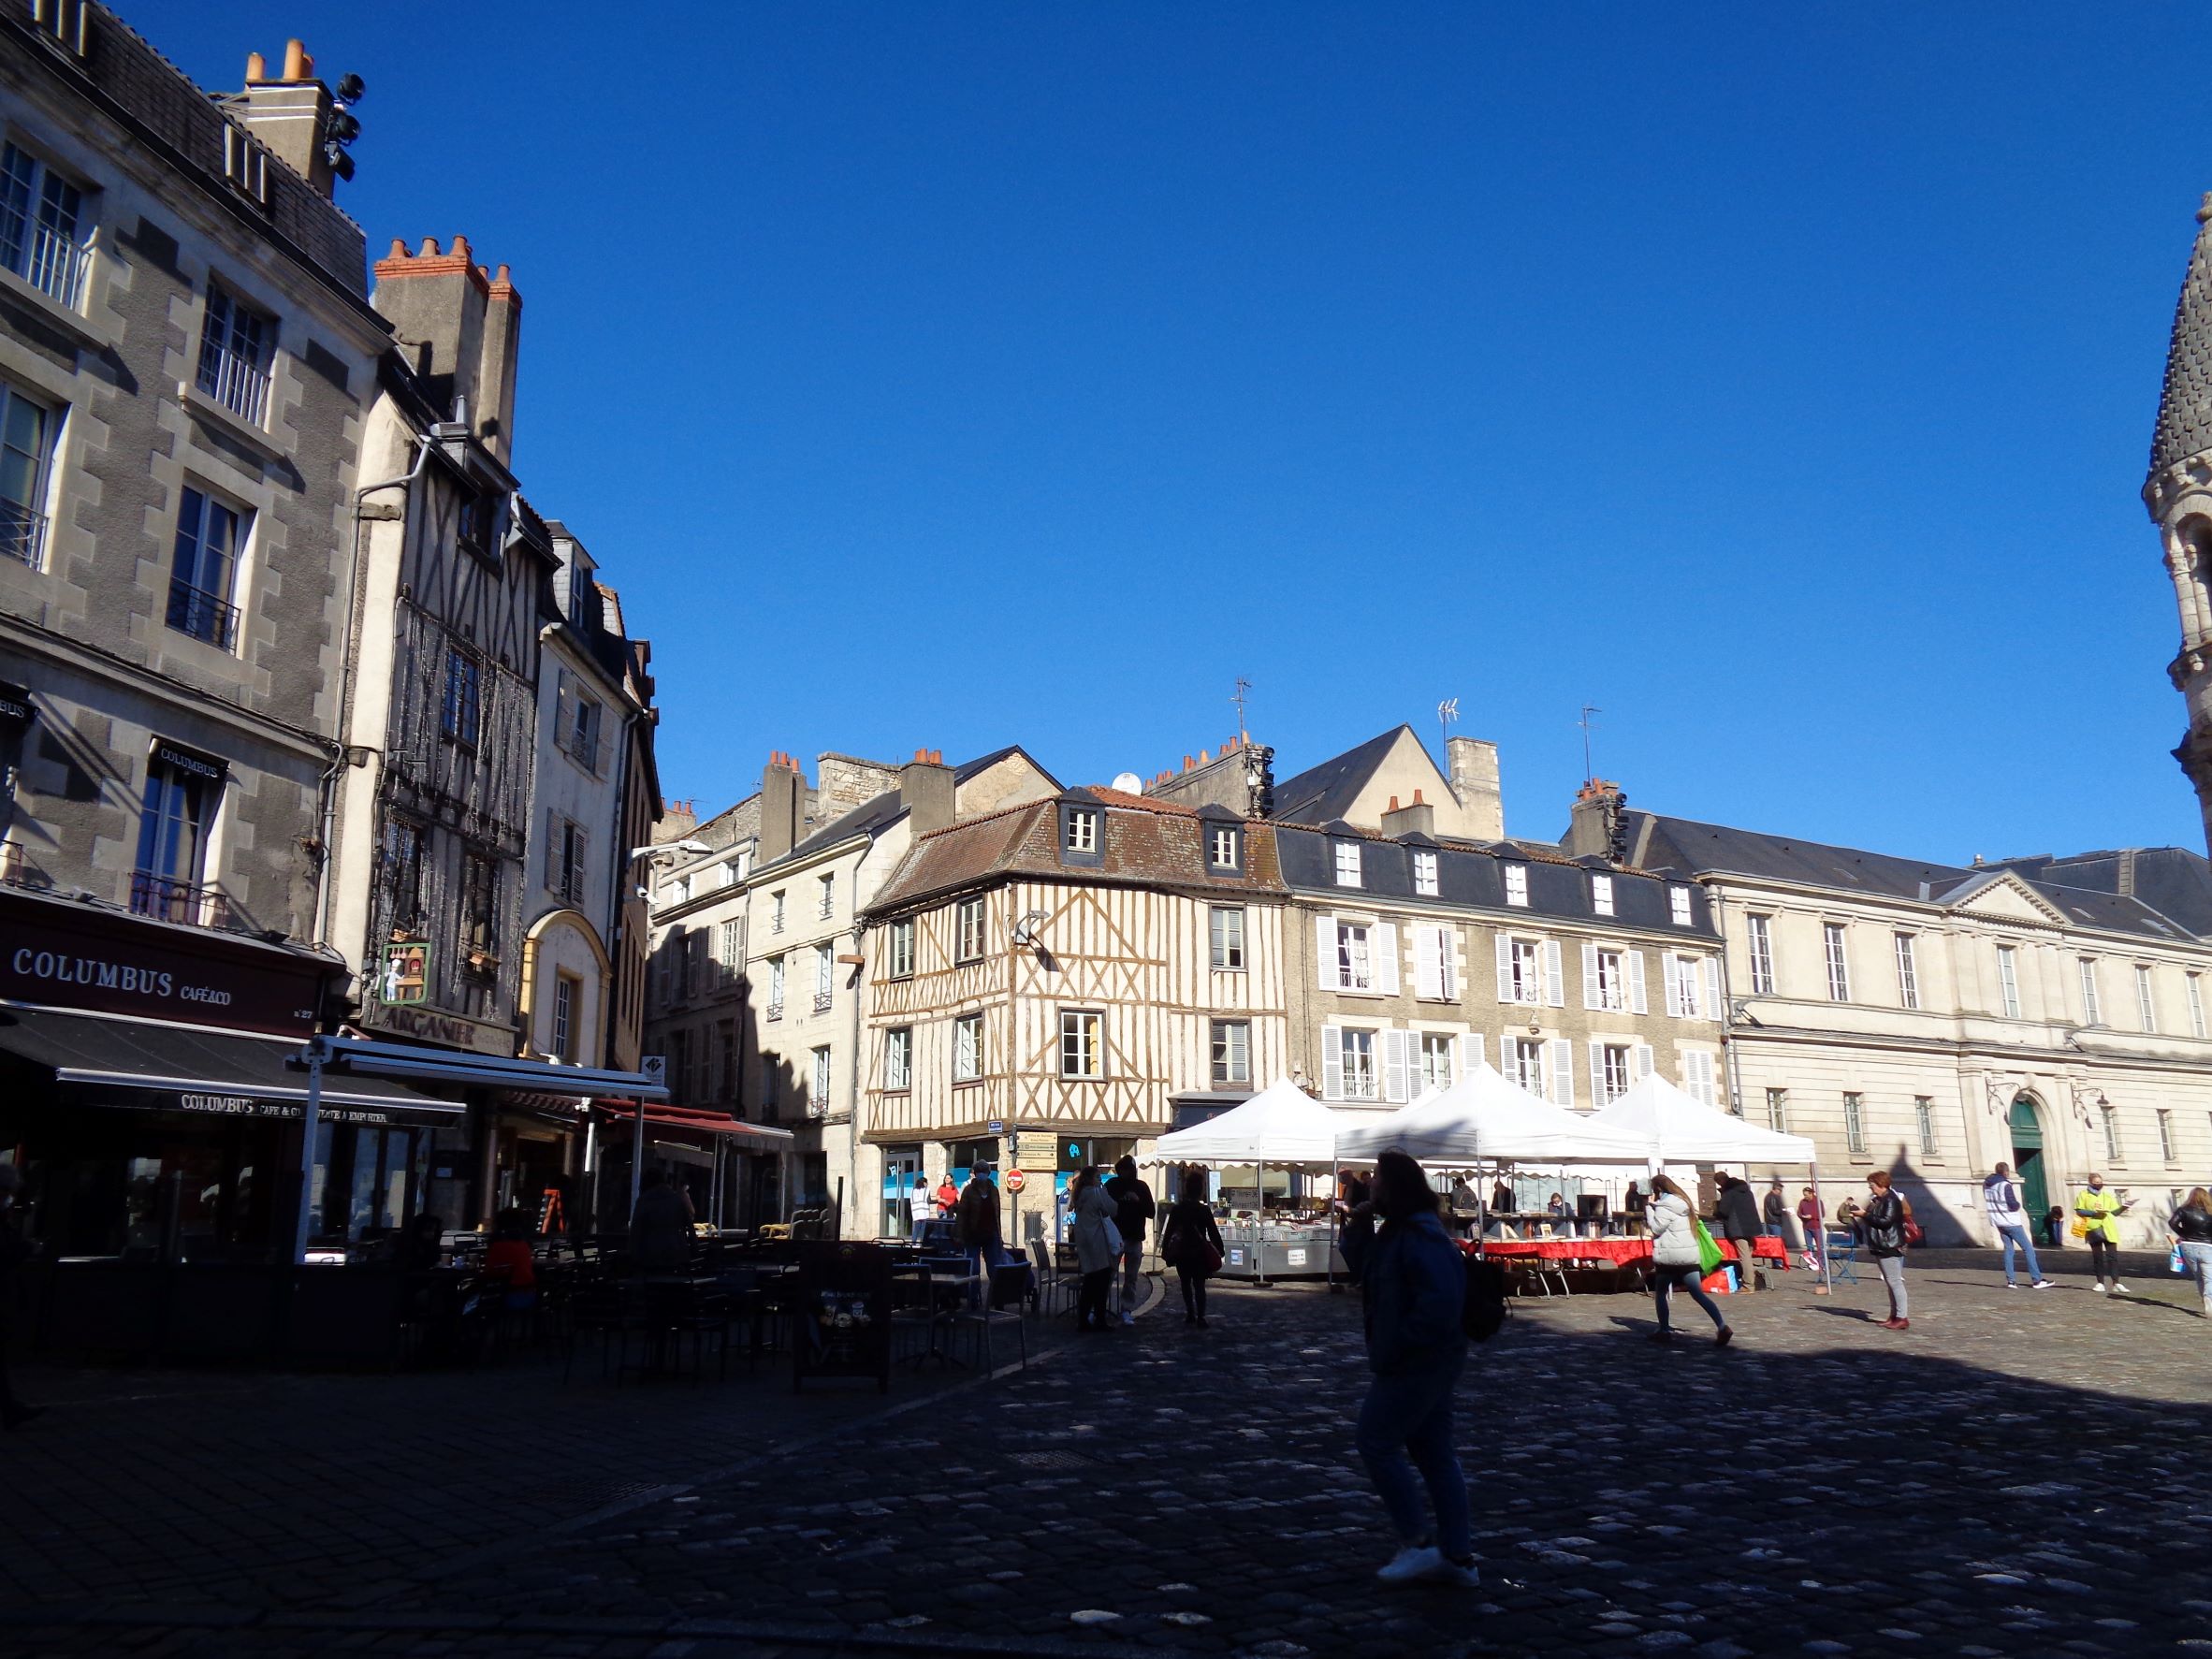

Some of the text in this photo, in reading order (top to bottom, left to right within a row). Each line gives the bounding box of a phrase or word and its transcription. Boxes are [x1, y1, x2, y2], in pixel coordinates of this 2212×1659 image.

[161, 749, 218, 778] COLUMBUS
[13, 948, 172, 997] COLUMBUS
[181, 1094, 255, 1114] COLUMBUS
